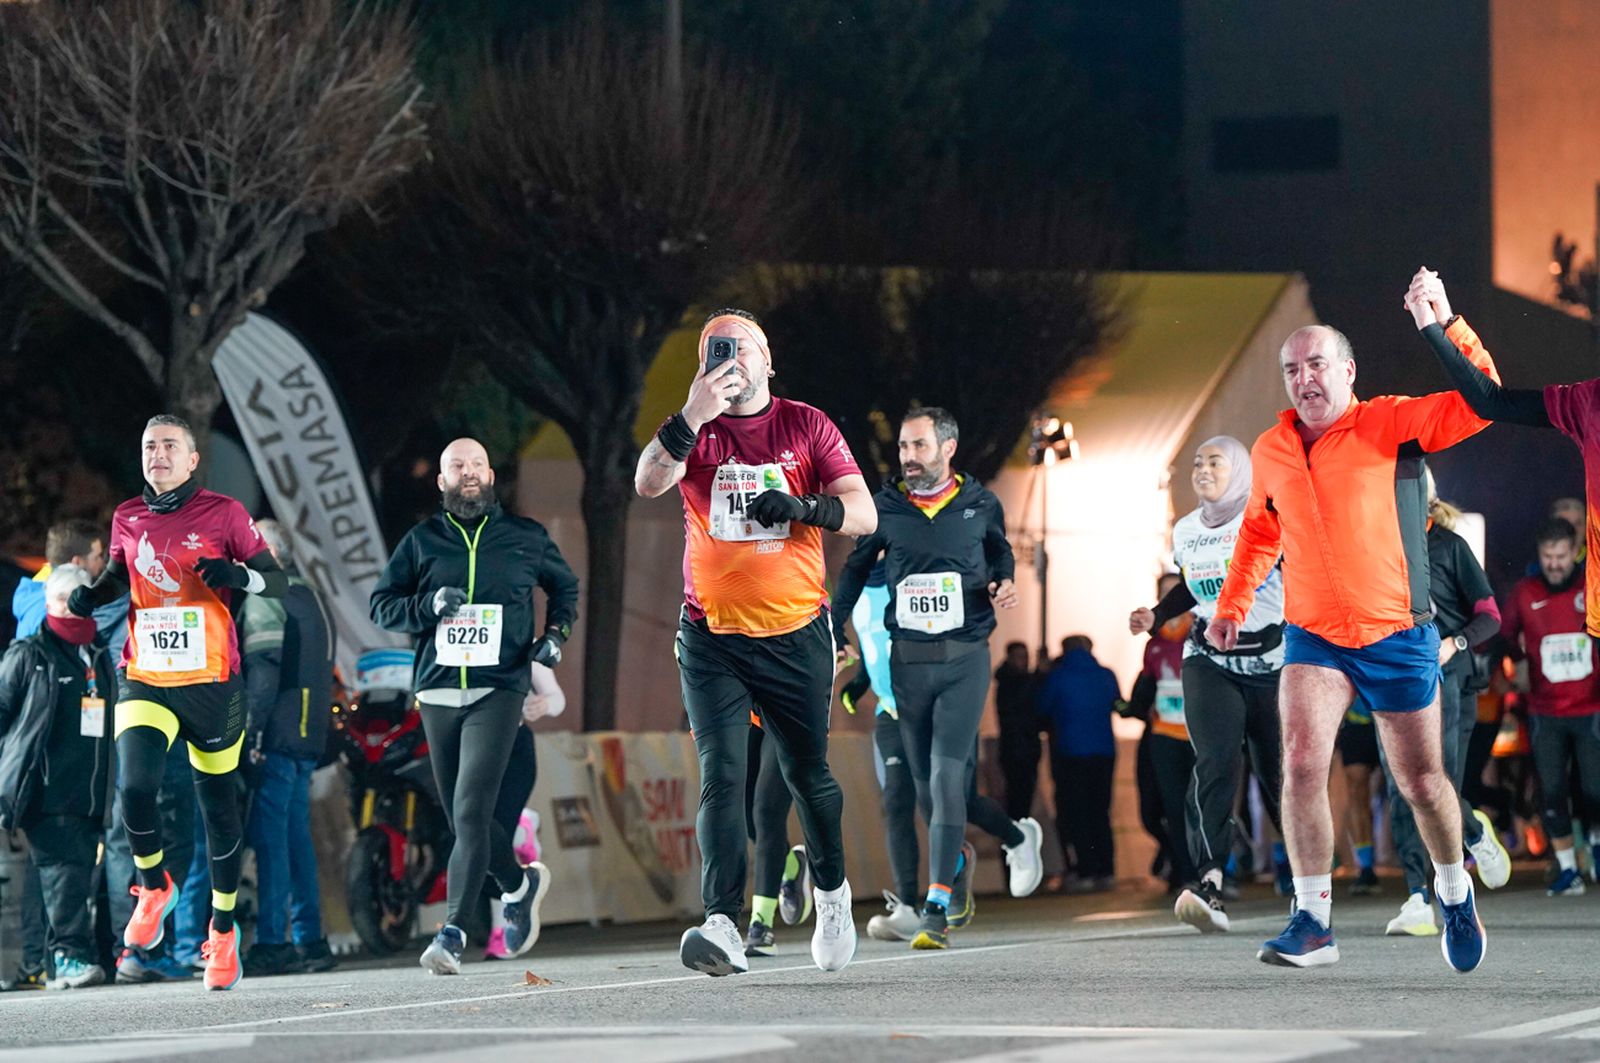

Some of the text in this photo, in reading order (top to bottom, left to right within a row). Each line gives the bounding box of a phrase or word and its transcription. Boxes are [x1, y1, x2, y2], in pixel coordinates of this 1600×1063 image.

[278, 362, 381, 585] JAPEMASA
[718, 483, 732, 491] SAN
[1183, 529, 1237, 553] alderó
[147, 565, 164, 583] 43
[910, 595, 949, 613] 6619
[149, 630, 189, 649] 1621
[447, 627, 489, 645] 6226
